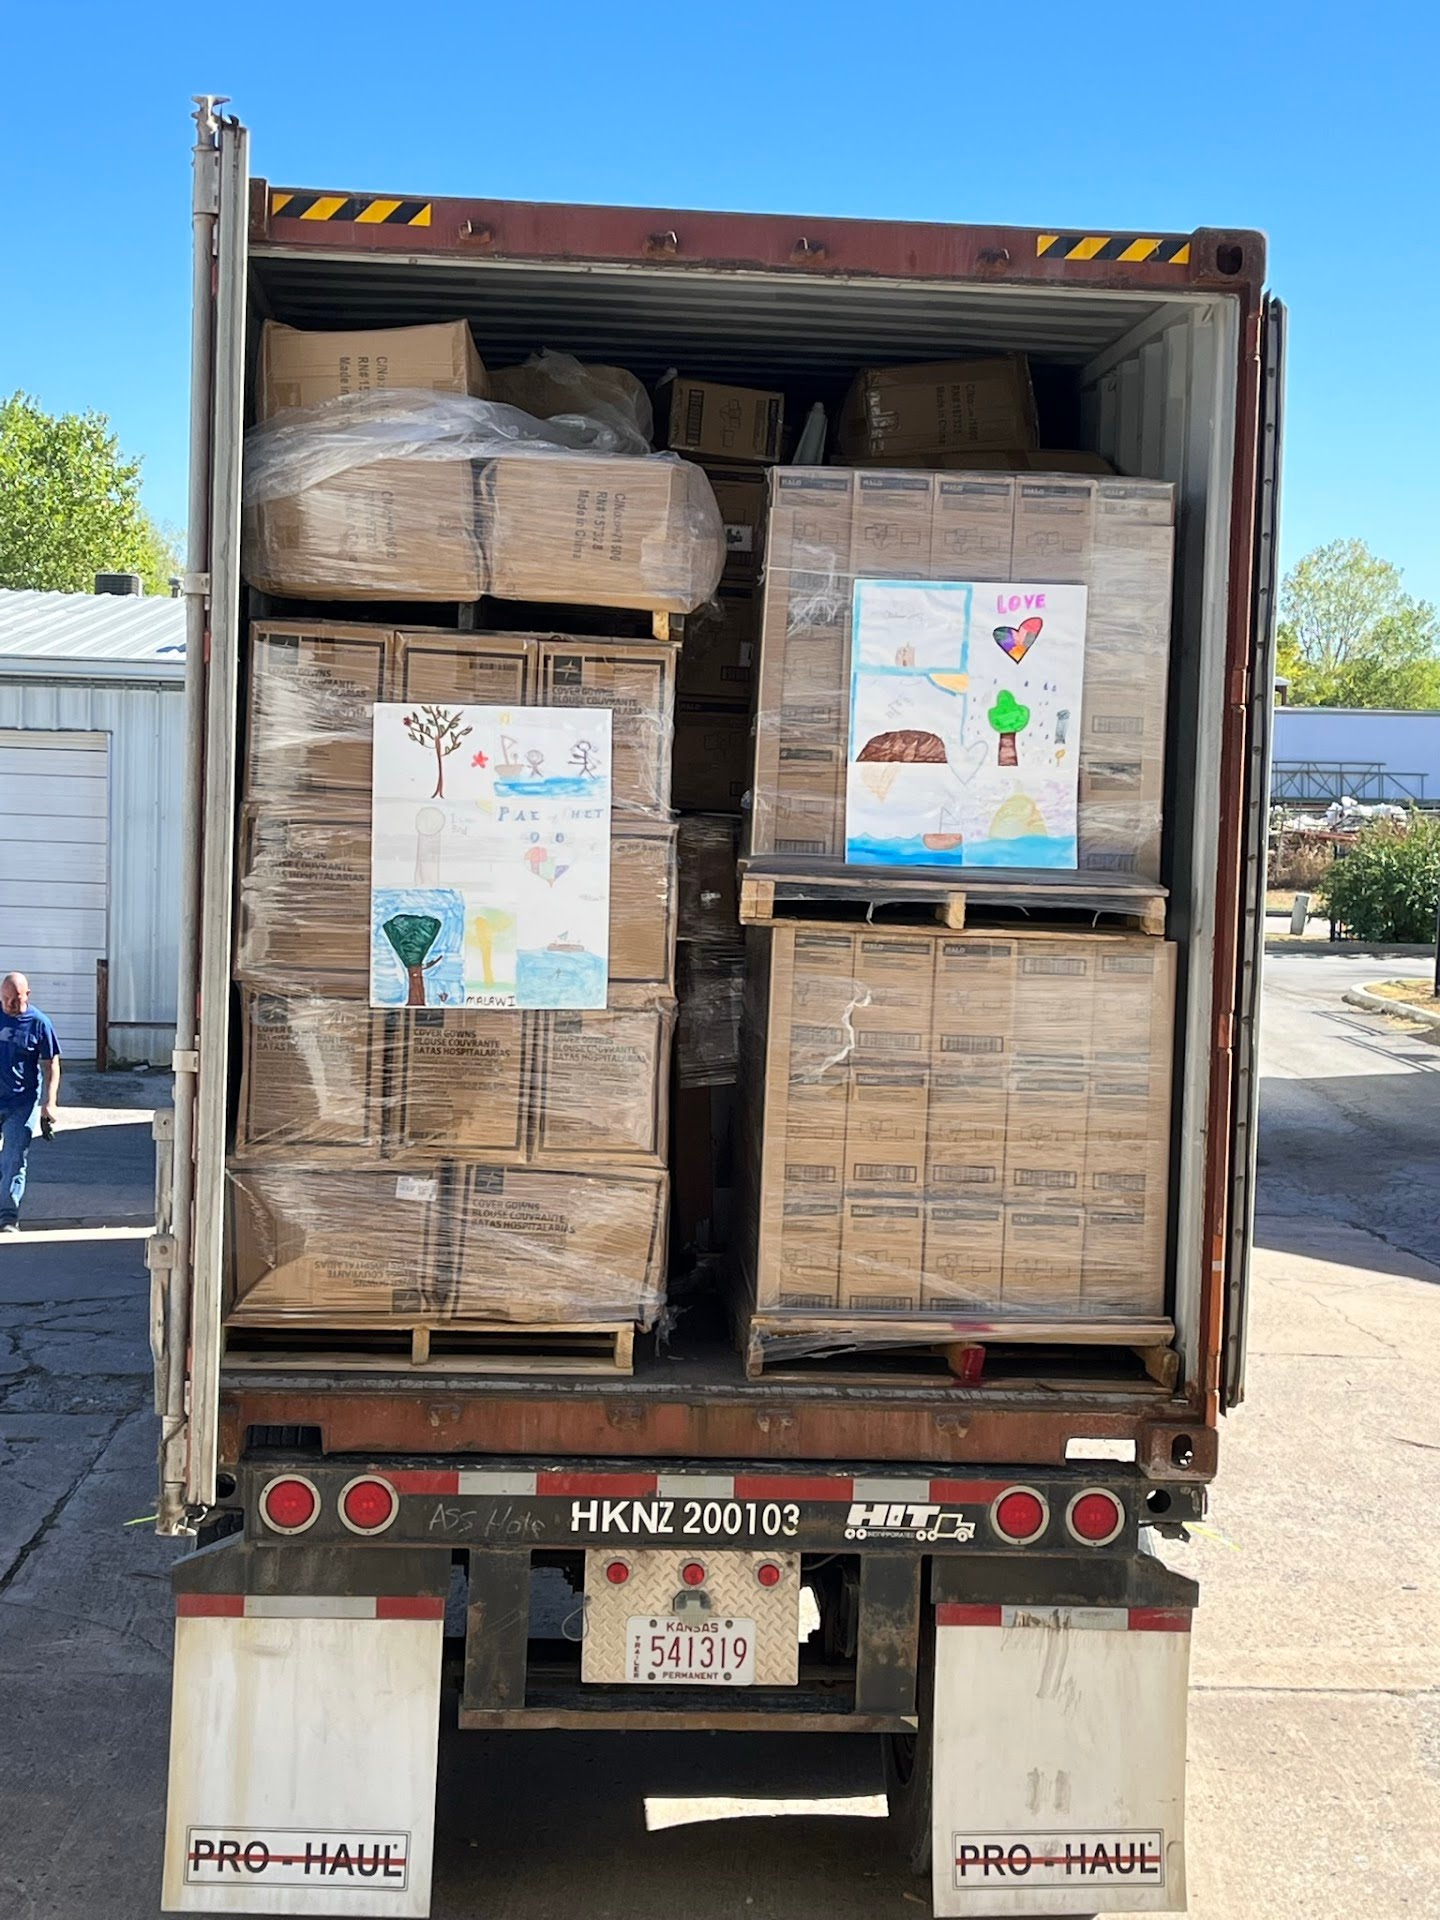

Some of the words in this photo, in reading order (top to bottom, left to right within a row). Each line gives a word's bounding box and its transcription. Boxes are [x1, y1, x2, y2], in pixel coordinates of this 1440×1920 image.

[339, 356, 351, 384] Made
[340, 386, 350, 396] in
[997, 594, 1046, 614] LOVE
[552, 686, 580, 695] COVER
[582, 687, 614, 696] GOWNS
[289, 870, 365, 881] HOSPITALARIAS
[466, 996, 516, 1007] MALAWI
[413, 1028, 441, 1037] COVER
[443, 1030, 477, 1039] GOWNS
[413, 1038, 446, 1047] BLOUSE
[448, 1040, 500, 1049] COUVRANTE
[552, 1044, 585, 1053] BLOUSE
[413, 1046, 442, 1055] BATAS
[443, 1048, 511, 1057] HOSPITALARIAS
[472, 1200, 503, 1209] COVER
[504, 1201, 540, 1210] GOWNS
[472, 1208, 508, 1219] BLOUSE
[509, 1211, 565, 1223] COUVRANTE
[471, 1219, 501, 1229] BATAS
[503, 1221, 576, 1234] HOSPITALARIAS
[327, 1270, 384, 1279] COUVRANTE
[571, 1500, 674, 1534] HKNZ
[683, 1502, 801, 1536] 200103
[846, 1503, 941, 1527] HIT
[666, 1622, 719, 1633] KANSAS
[633, 1635, 641, 1678] TRAILER
[651, 1635, 748, 1669] 541319
[662, 1671, 719, 1680] PERMANENT
[192, 1839, 270, 1874] PRO
[304, 1842, 403, 1878] HAUL
[960, 1843, 1032, 1877] PRO
[1065, 1842, 1159, 1875] HAUL
